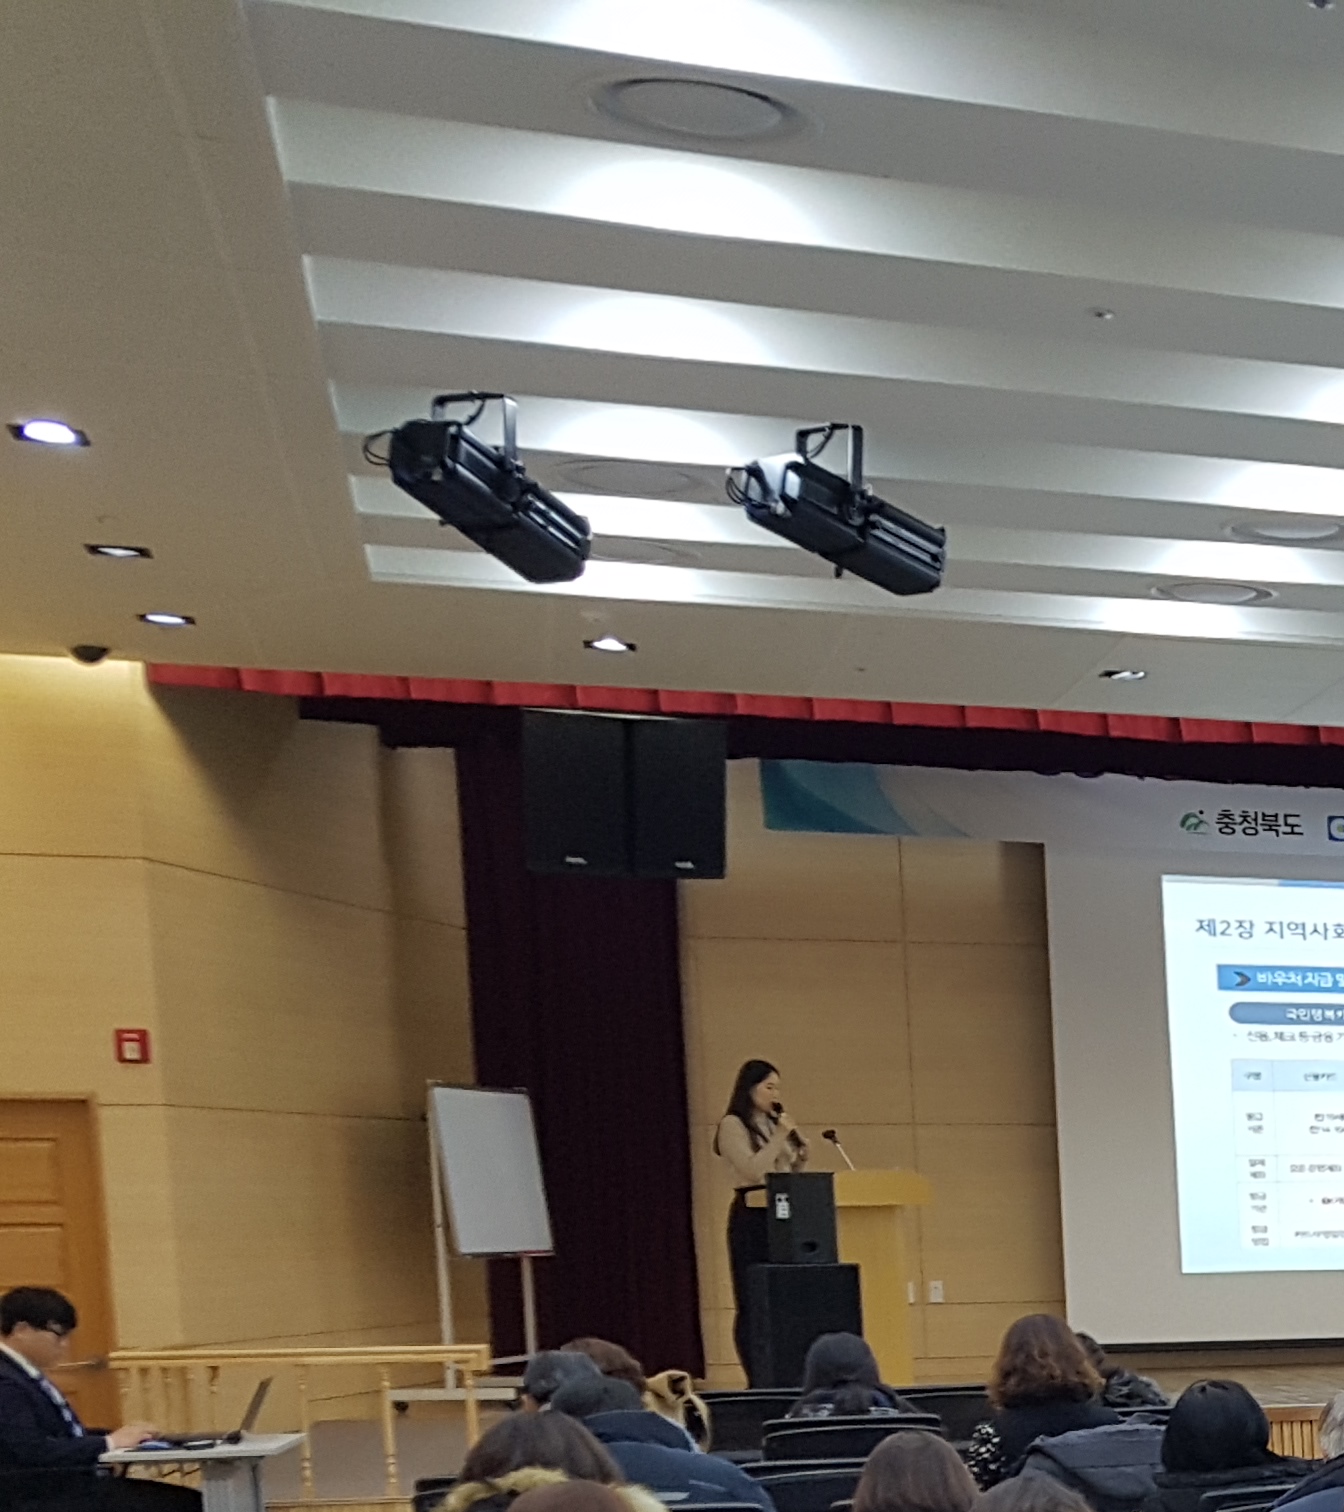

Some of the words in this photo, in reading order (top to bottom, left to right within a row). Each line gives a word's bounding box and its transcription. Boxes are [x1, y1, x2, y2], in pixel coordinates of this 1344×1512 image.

[1215, 809, 1304, 837] 충청북도
[1195, 918, 1255, 940] 제2장
[1256, 971, 1302, 987] 바우처
